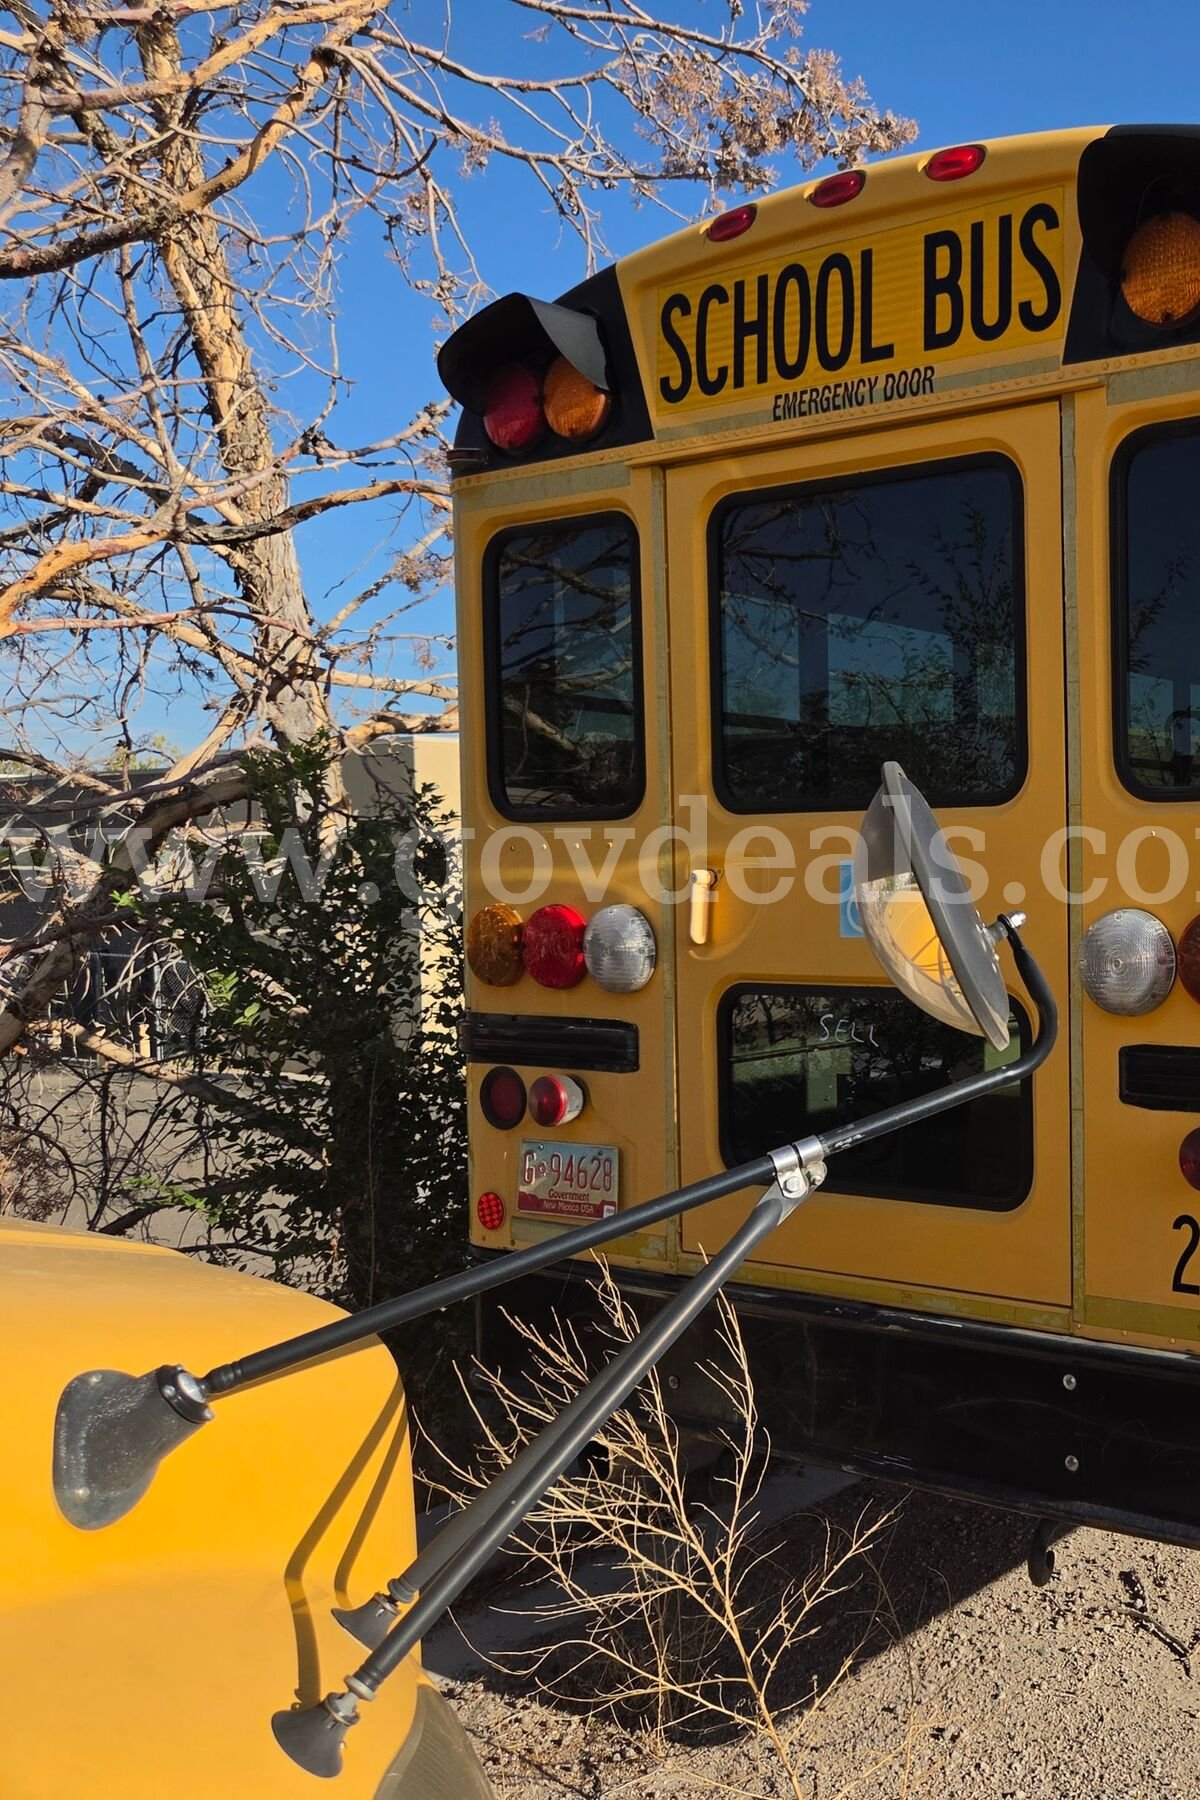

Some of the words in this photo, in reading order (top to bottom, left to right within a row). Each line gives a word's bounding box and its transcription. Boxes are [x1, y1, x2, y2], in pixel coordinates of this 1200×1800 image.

[659, 248, 894, 403] SCHOOL
[923, 203, 1062, 351] BUS
[772, 376, 880, 422] EMERGENCY
[883, 365, 935, 401] DOOR
[543, 1200, 556, 1209] New
[558, 1201, 580, 1212] Mexico
[581, 1204, 594, 1214] USA
[548, 1188, 590, 1201] Government
